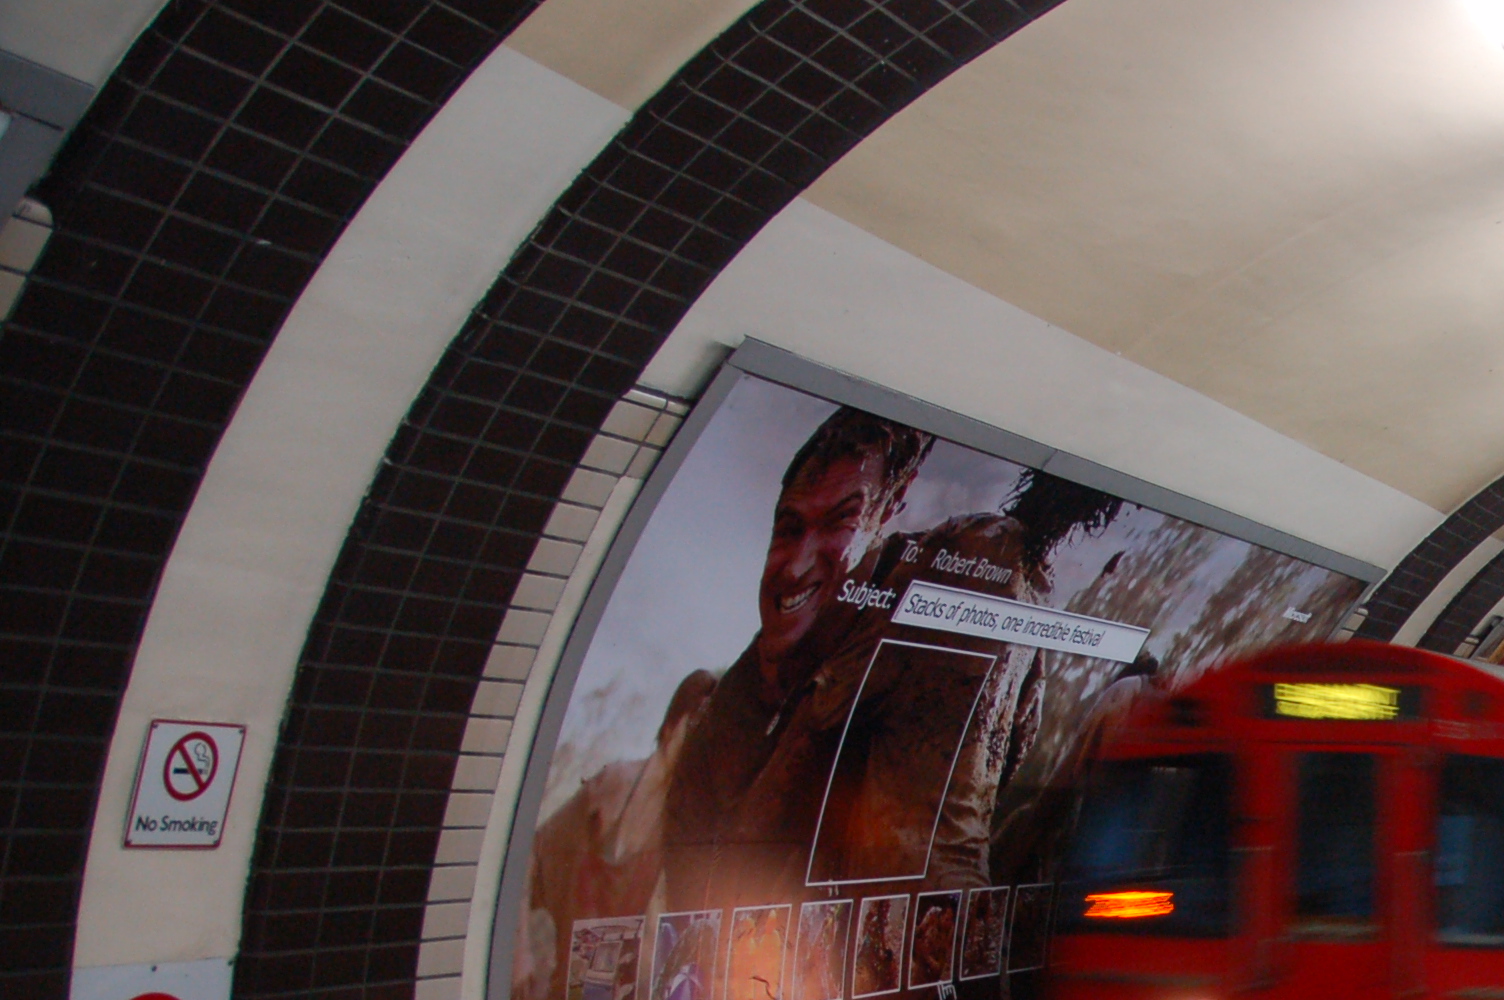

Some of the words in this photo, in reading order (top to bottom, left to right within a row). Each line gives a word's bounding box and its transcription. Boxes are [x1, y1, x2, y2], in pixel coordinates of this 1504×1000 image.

[899, 539, 925, 563] To:
[930, 549, 975, 577] Robert
[973, 557, 1014, 585] Brown
[837, 578, 897, 610] Subject:
[904, 593, 946, 619] Stacks
[945, 601, 962, 619] of
[955, 604, 999, 632] photos,
[1001, 615, 1024, 632] one
[1023, 616, 1072, 642] incredible
[1068, 625, 1106, 648] festival
[134, 815, 157, 833] No
[160, 814, 218, 836] Smoking
